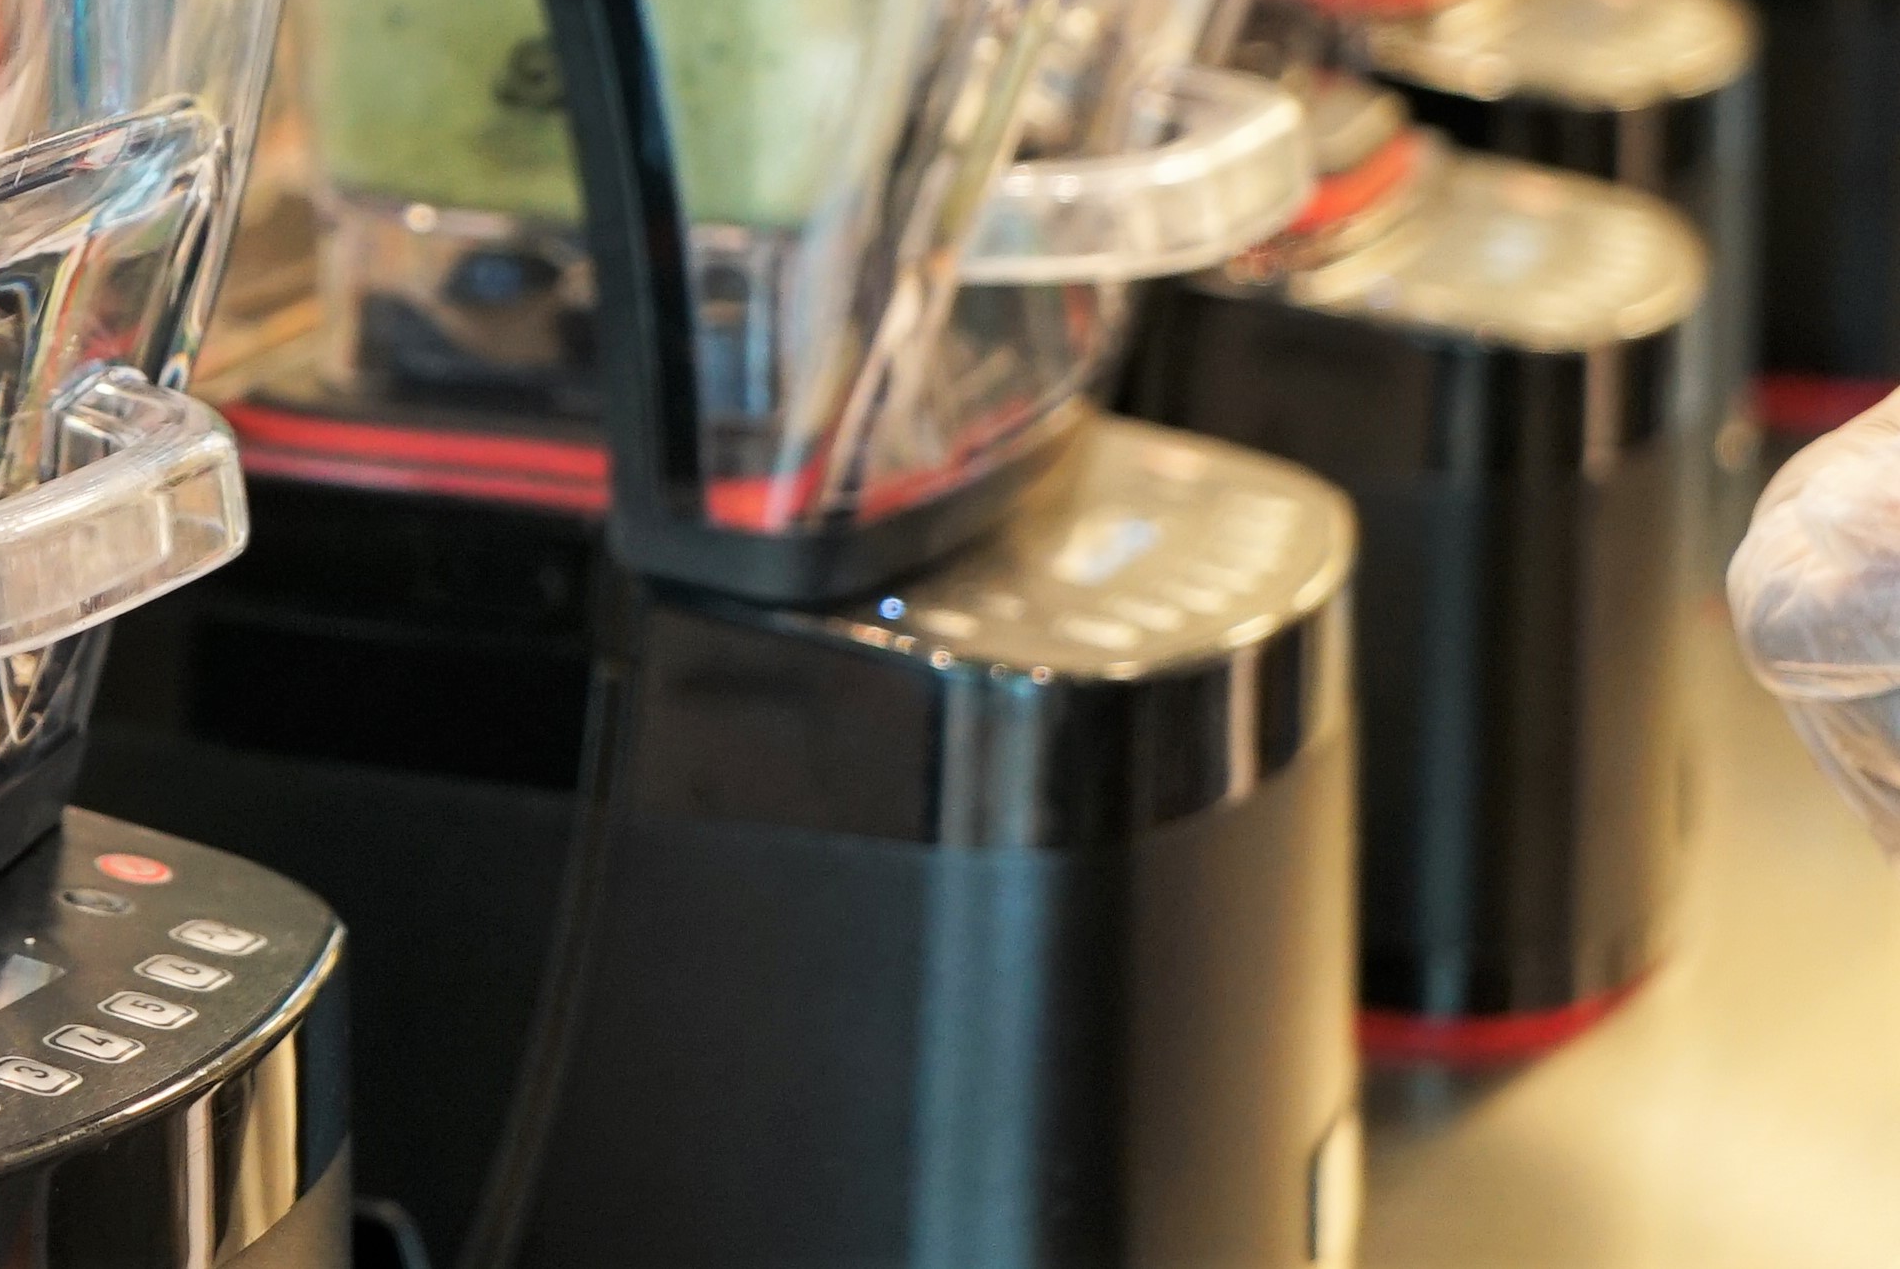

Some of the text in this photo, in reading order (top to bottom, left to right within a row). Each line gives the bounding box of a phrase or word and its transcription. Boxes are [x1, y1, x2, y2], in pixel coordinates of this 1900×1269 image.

[167, 963, 201, 976] 6
[128, 999, 167, 1014] 5
[79, 1033, 115, 1048] 4
[14, 1065, 50, 1079] 3
